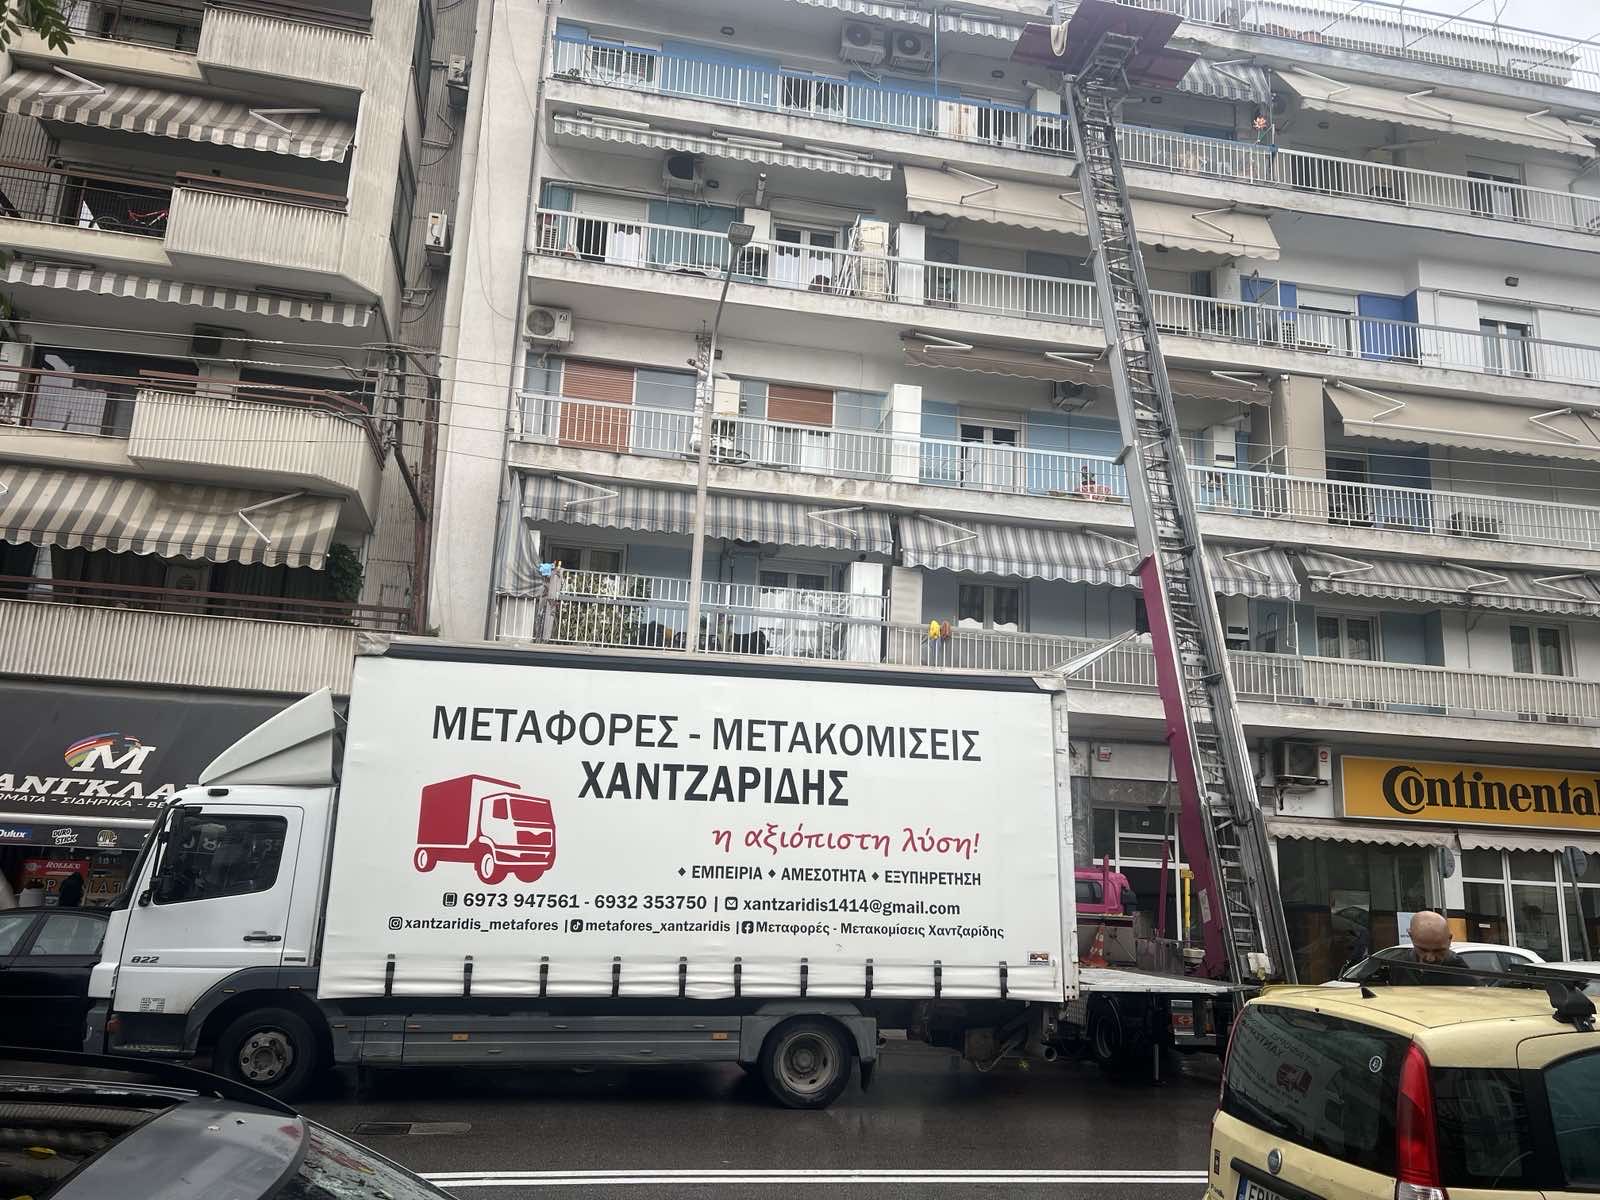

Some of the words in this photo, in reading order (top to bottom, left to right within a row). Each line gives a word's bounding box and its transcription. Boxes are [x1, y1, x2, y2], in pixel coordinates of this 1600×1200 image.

[432, 705, 679, 749] ΜΕΤΑΦΟΡΕΣ
[713, 717, 982, 762] ΜΕΤΑΚΟΜΙΣΕΙΣ
[577, 760, 849, 807] ΧΑΝΤΖΑΡΙΔΗΣ
[61, 797, 132, 807] ΣΙΔΗΡΙΚΑ
[711, 829, 732, 853] η
[744, 823, 890, 857] αξιόπιστη
[902, 827, 980, 860] λύση!
[691, 865, 763, 881] ΕΜΠΕΙΡΙΑ
[780, 867, 867, 883] ΑΜΕΣΟΤΗΤΑ
[884, 870, 981, 886] ΕΞΥΠΗΡΕΤΗΣΗ
[463, 892, 508, 908] 6973
[513, 893, 580, 909] 947561
[594, 894, 638, 910] 6932
[642, 895, 707, 911] 353750
[743, 896, 961, 917] xantzaridis1414@gmail.com
[404, 917, 559, 933] xantzaridis_metafores
[585, 920, 731, 934] metafores_xantzaridis
[756, 923, 830, 938] Μεταφορές
[840, 923, 926, 938] Μετακομίσεις
[928, 924, 1005, 940] Χαντζαρίδης
[131, 955, 160, 964] 822
